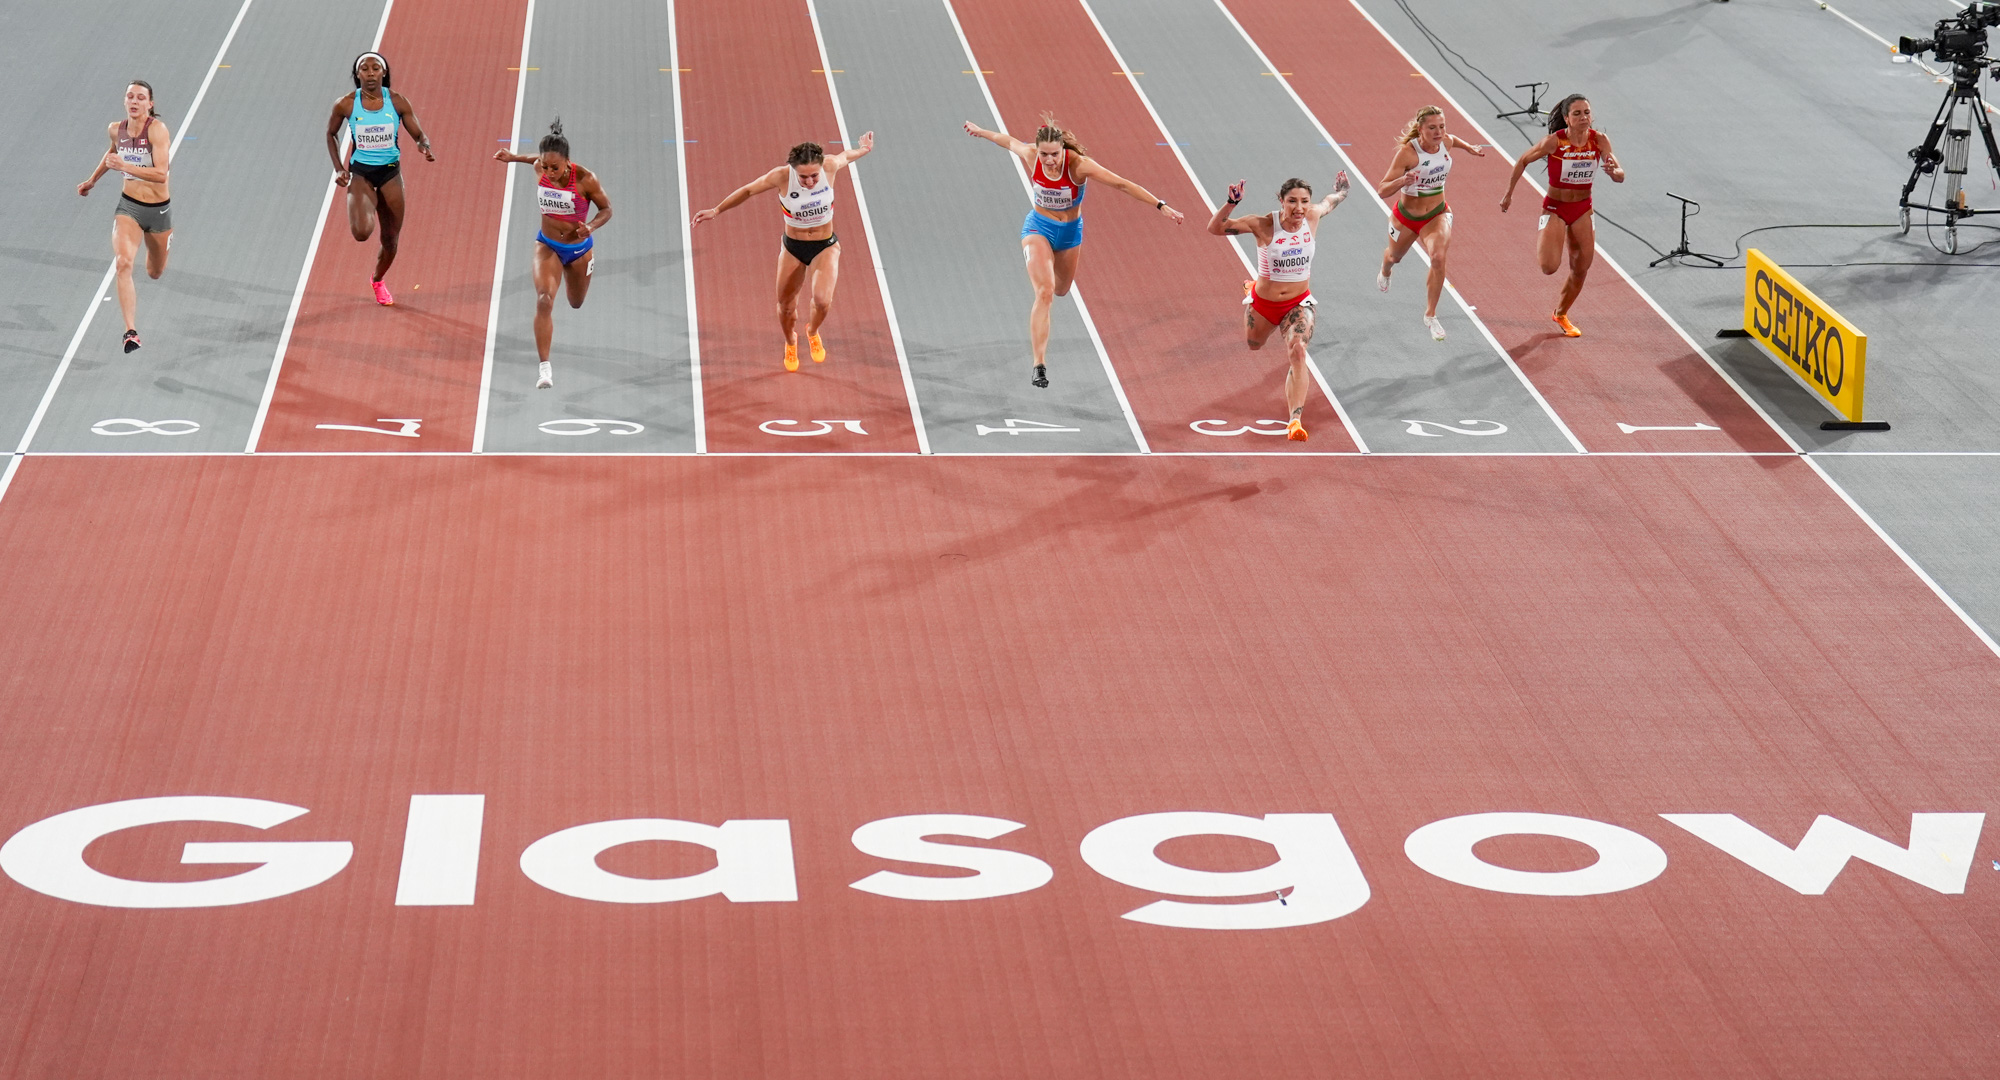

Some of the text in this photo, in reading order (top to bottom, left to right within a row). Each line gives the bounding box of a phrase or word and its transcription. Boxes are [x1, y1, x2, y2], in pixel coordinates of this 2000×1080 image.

[358, 134, 392, 143] STRACHAN
[119, 146, 148, 154] CANADA
[1567, 170, 1594, 178] PÉREZ
[539, 198, 571, 209] BARNES
[1043, 195, 1053, 203] DER
[795, 205, 828, 217] ROSIUS
[1390, 227, 1395, 237] 2
[1273, 256, 1310, 268] SWOBODA
[1754, 270, 1844, 396] SEIKO
[91, 418, 200, 437] 8
[315, 419, 422, 437] 7
[538, 419, 645, 436] 6
[759, 419, 869, 436] 5
[976, 418, 1081, 436] 4
[1189, 419, 1292, 437] 3
[1401, 419, 1508, 437] 2
[1616, 422, 1721, 434] 1
[0, 794, 1985, 930] Glasgow
